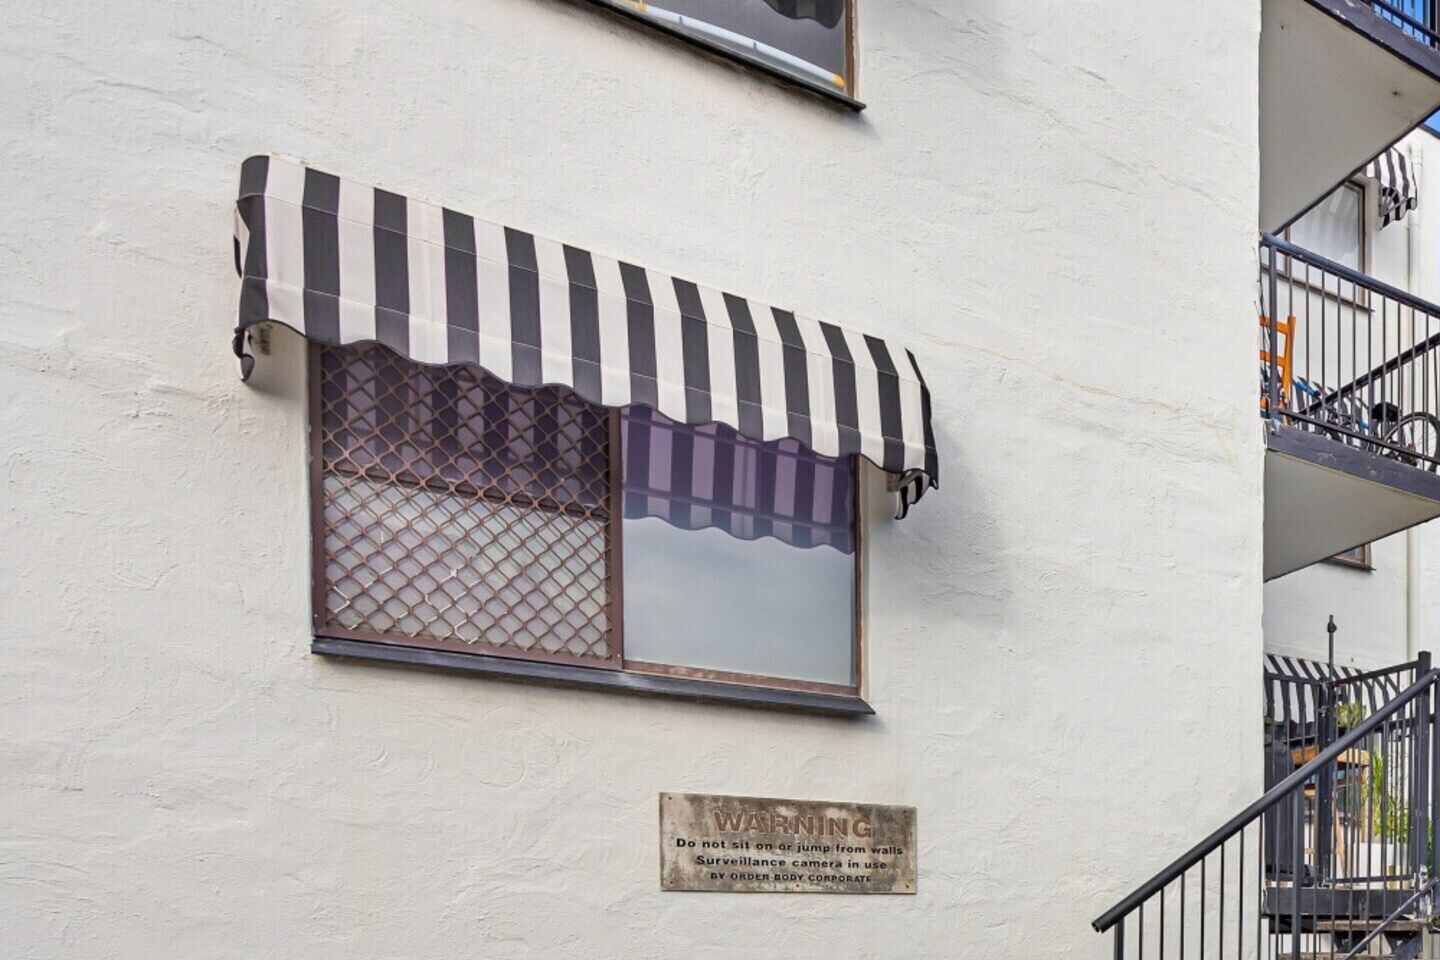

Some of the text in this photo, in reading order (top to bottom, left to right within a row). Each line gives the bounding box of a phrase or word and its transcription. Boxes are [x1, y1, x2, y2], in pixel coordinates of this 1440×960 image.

[713, 811, 874, 838] WARNING
[676, 838, 903, 855] Do not sit on or jump from walls
[696, 855, 887, 869] Surveillance camera in use
[730, 873, 770, 881] ORDER
[774, 873, 803, 882] BODY
[808, 875, 872, 883] CORPORATE
